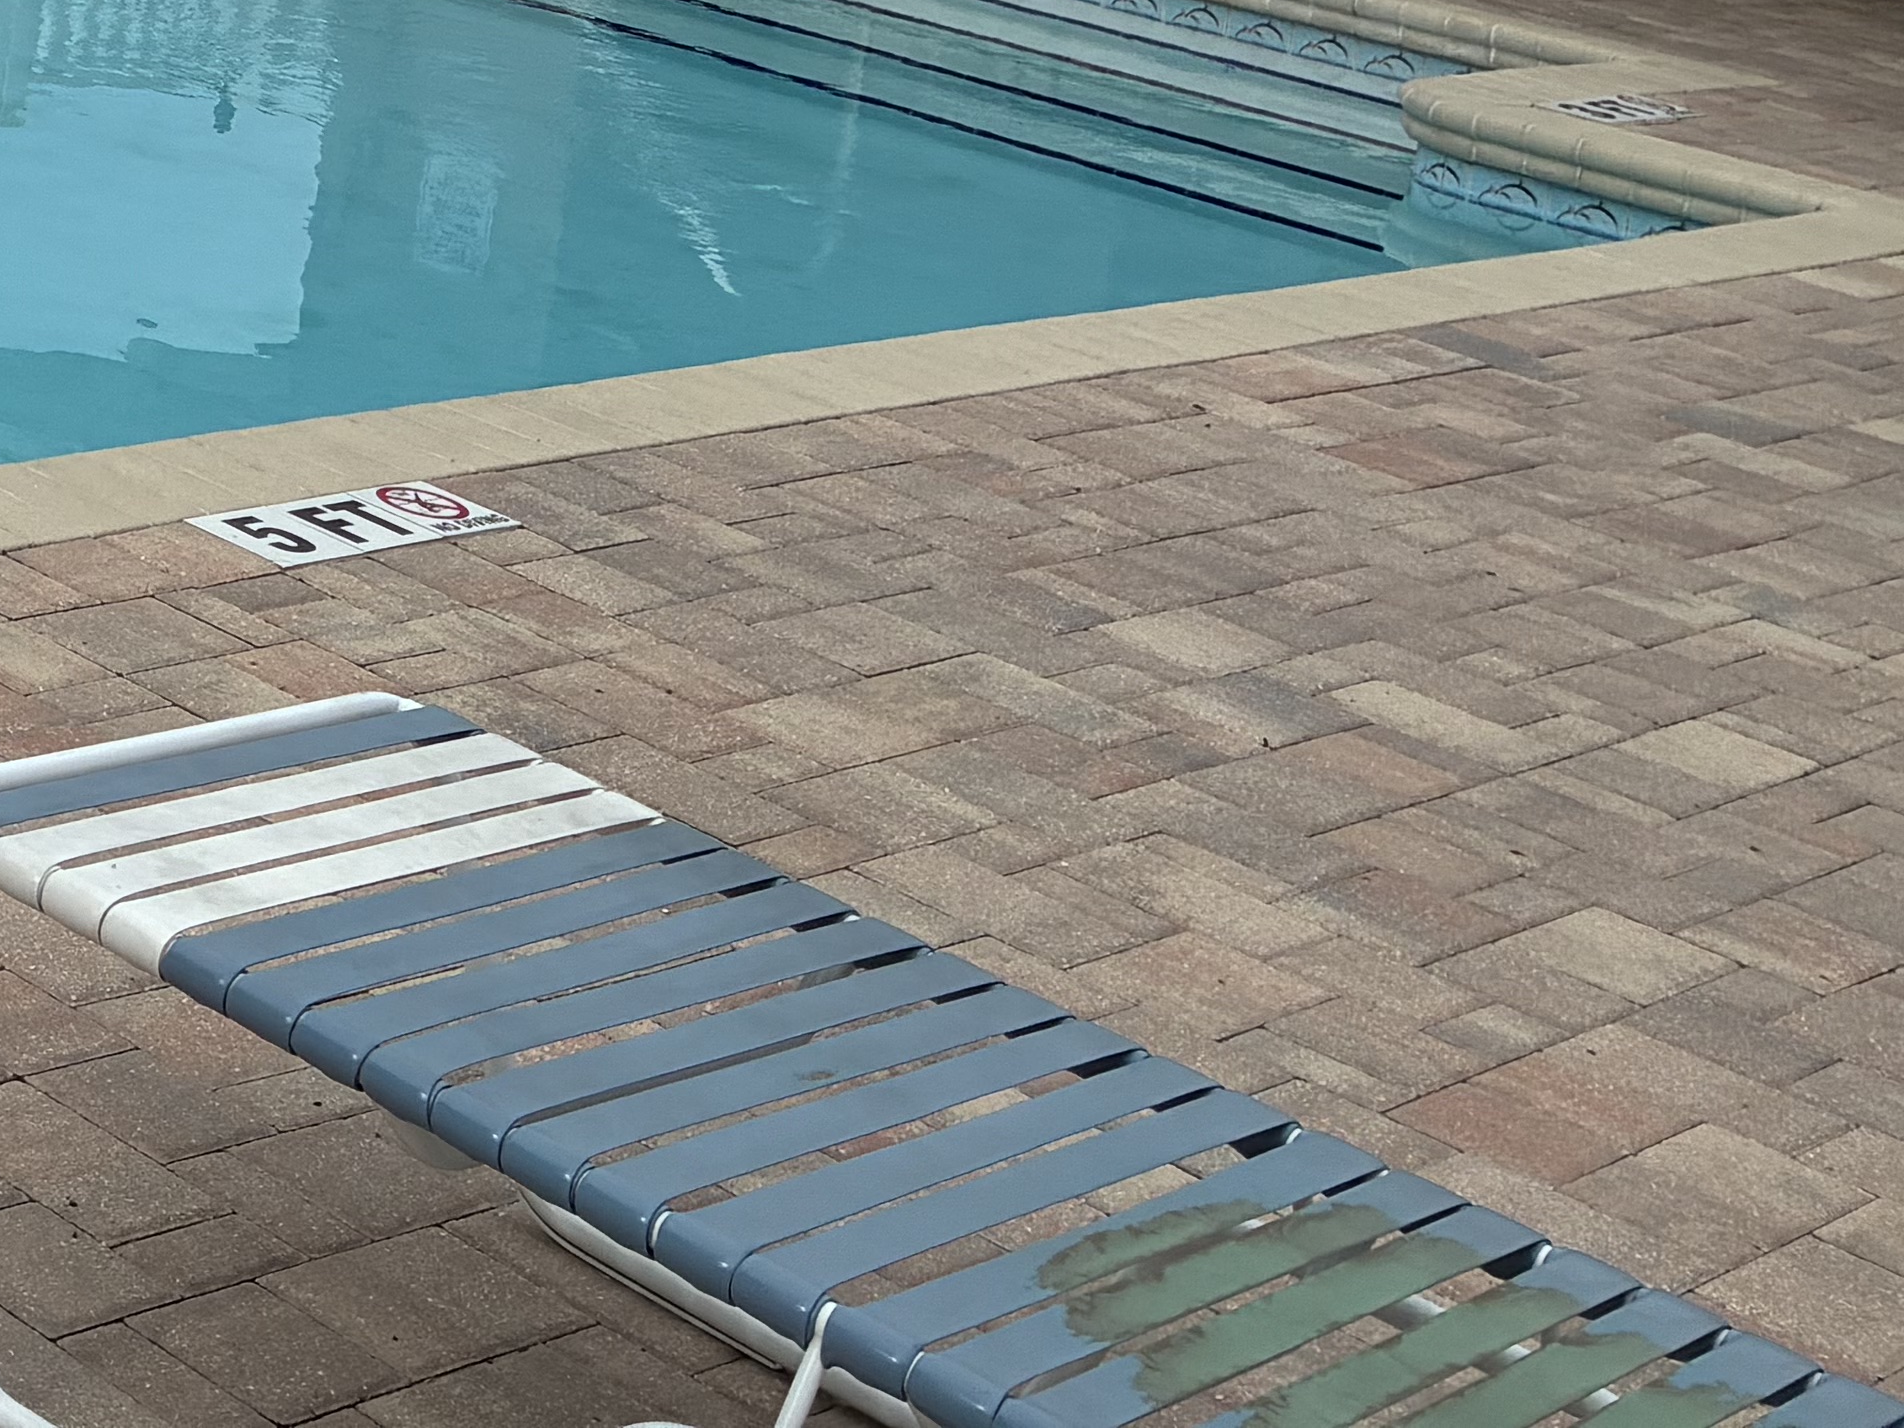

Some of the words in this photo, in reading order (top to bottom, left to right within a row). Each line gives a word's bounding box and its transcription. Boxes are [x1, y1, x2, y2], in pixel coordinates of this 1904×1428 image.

[222, 515, 316, 553] 5
[288, 500, 414, 544] FT
[429, 522, 461, 532] NO
